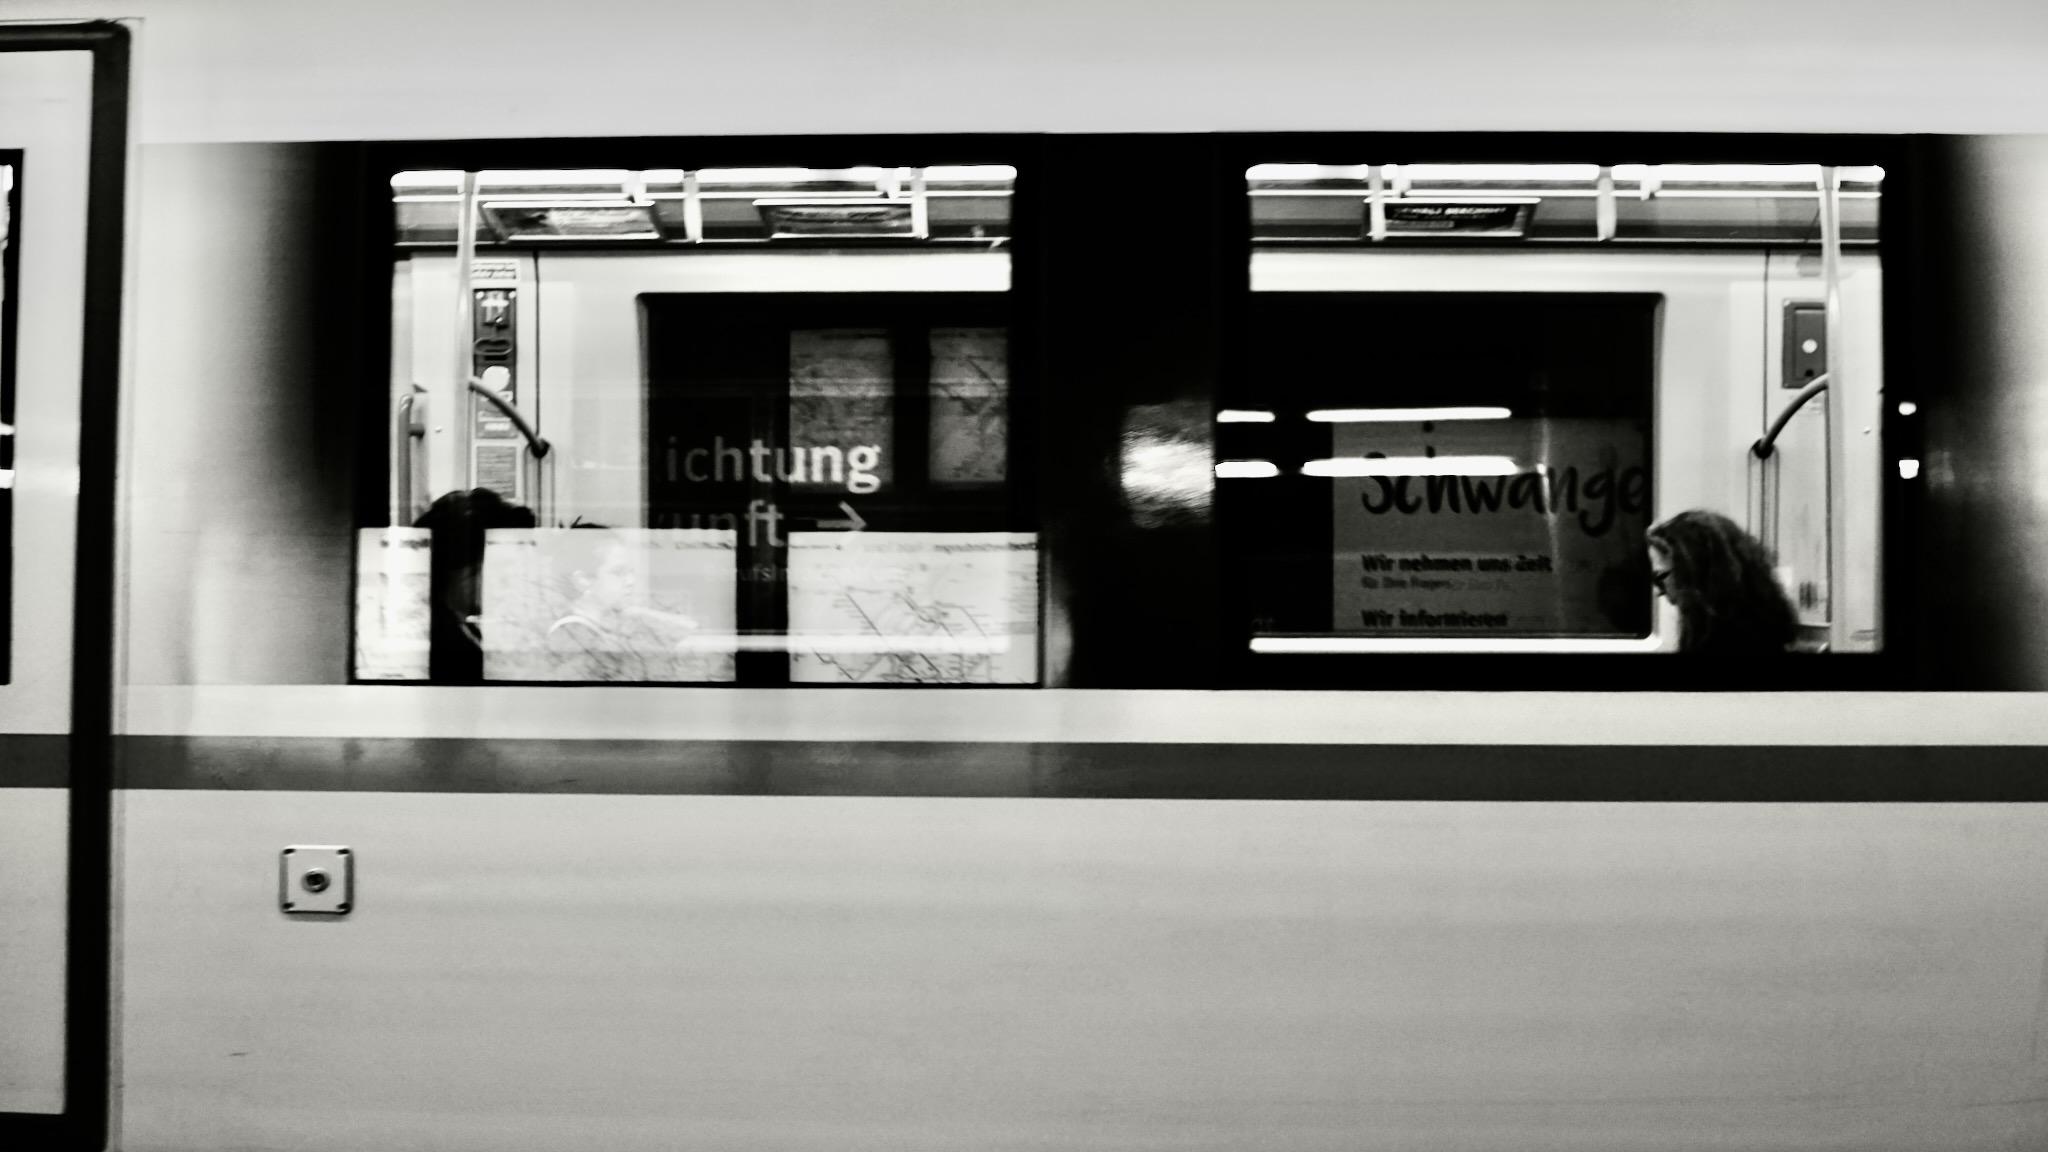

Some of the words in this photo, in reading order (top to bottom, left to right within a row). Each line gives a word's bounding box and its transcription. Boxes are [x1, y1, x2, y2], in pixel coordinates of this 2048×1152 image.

[656, 436, 881, 494] ichtung
[1362, 554, 1394, 572] Wir
[1398, 554, 1474, 572] nehmen
[1477, 557, 1512, 572] uns
[1362, 609, 1394, 628] Wir
